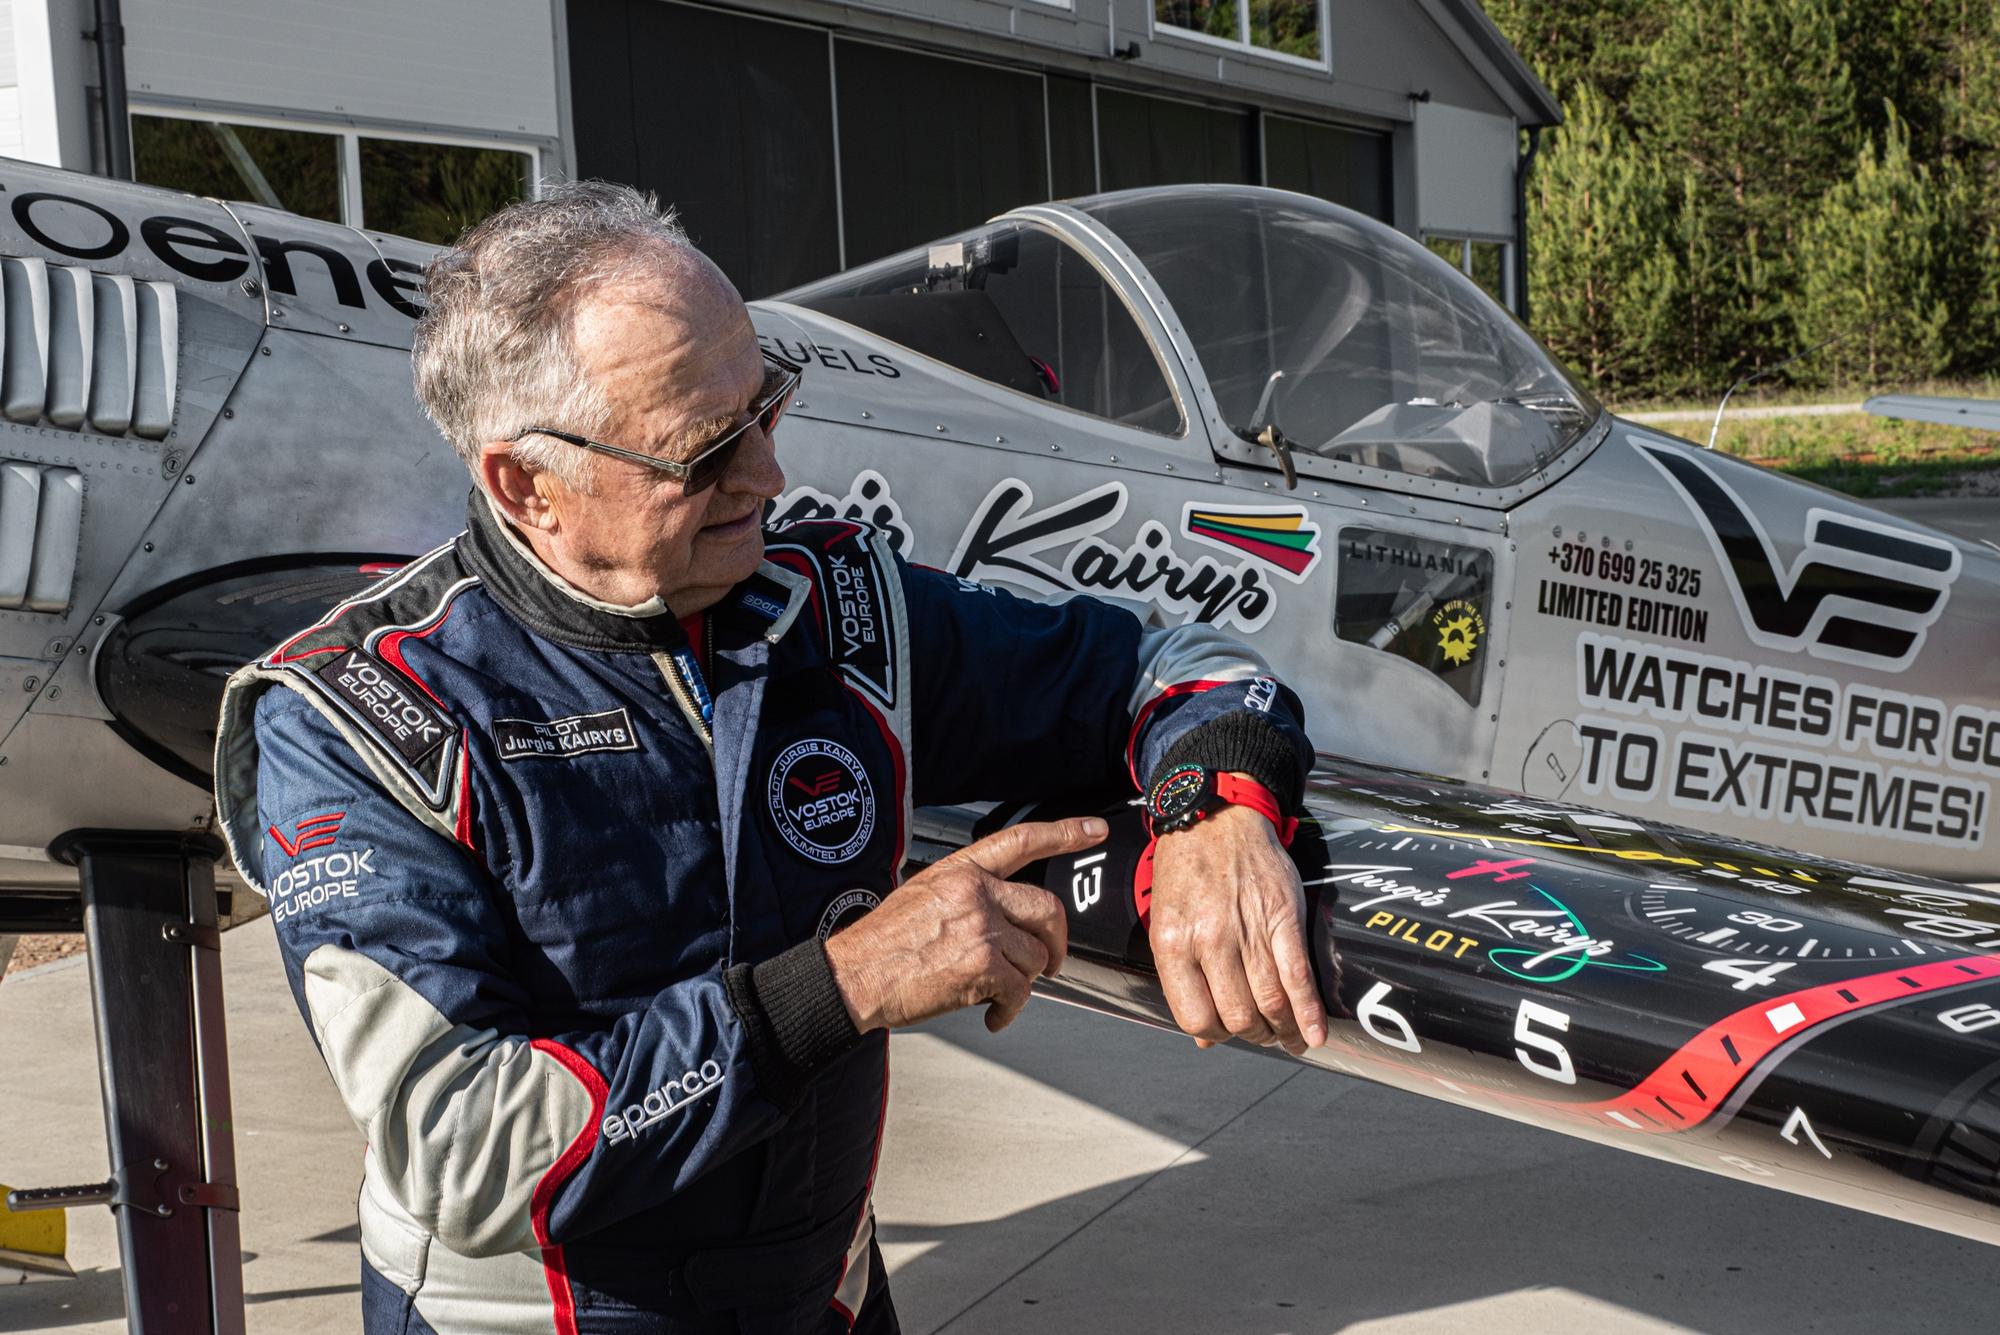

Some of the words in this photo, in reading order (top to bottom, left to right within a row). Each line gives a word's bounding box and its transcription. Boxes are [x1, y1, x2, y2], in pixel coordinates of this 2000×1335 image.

[955, 486, 1270, 624] Kairys
[1351, 541, 1480, 578] LITHUANIA
[1548, 542, 1595, 577] +370
[1597, 550, 1636, 586] 699
[1638, 558, 1663, 591] 25
[1665, 564, 1702, 598] 325
[743, 594, 785, 617] sparc
[828, 555, 864, 657] VOSTOK
[851, 566, 877, 643] EUROPE
[1433, 608, 1445, 626] FLY
[1443, 600, 1463, 613] WITH
[1473, 613, 1486, 635] SUN
[1537, 579, 1624, 628] LIMITED
[1625, 596, 1709, 644] EDITION
[337, 671, 413, 741] EUROPE
[345, 651, 444, 742] VOSTOK
[1582, 643, 1835, 737] WATCHES
[1844, 694, 1941, 757] FOR
[505, 735, 556, 753] Jurgis
[558, 728, 628, 751] KAIRYS
[534, 720, 582, 738] PILOT
[772, 773, 783, 810] PILOT
[779, 742, 819, 773] JURGIS
[823, 743, 865, 782] KAIRYS
[788, 788, 861, 822] VOSTOK
[1580, 725, 1659, 793] TO
[1674, 741, 1986, 842] EXTREMES!
[781, 821, 838, 860] UNLIMITED
[840, 796, 874, 859] AEROBATICS
[803, 806, 856, 832] EUROPE
[266, 847, 377, 908] VOSTOK
[274, 879, 359, 924] EUROPE
[829, 892, 864, 921] JURGIS
[1736, 878, 1813, 895] 45
[1364, 910, 1480, 959] PILOT
[1447, 901, 1615, 969] Kairys
[1726, 910, 1804, 933] 30
[1701, 959, 1798, 992] 4
[1356, 981, 1422, 1053] 6
[1513, 998, 1577, 1085] 5
[603, 1060, 724, 1146] sparco
[1779, 1105, 1833, 1160] 7
